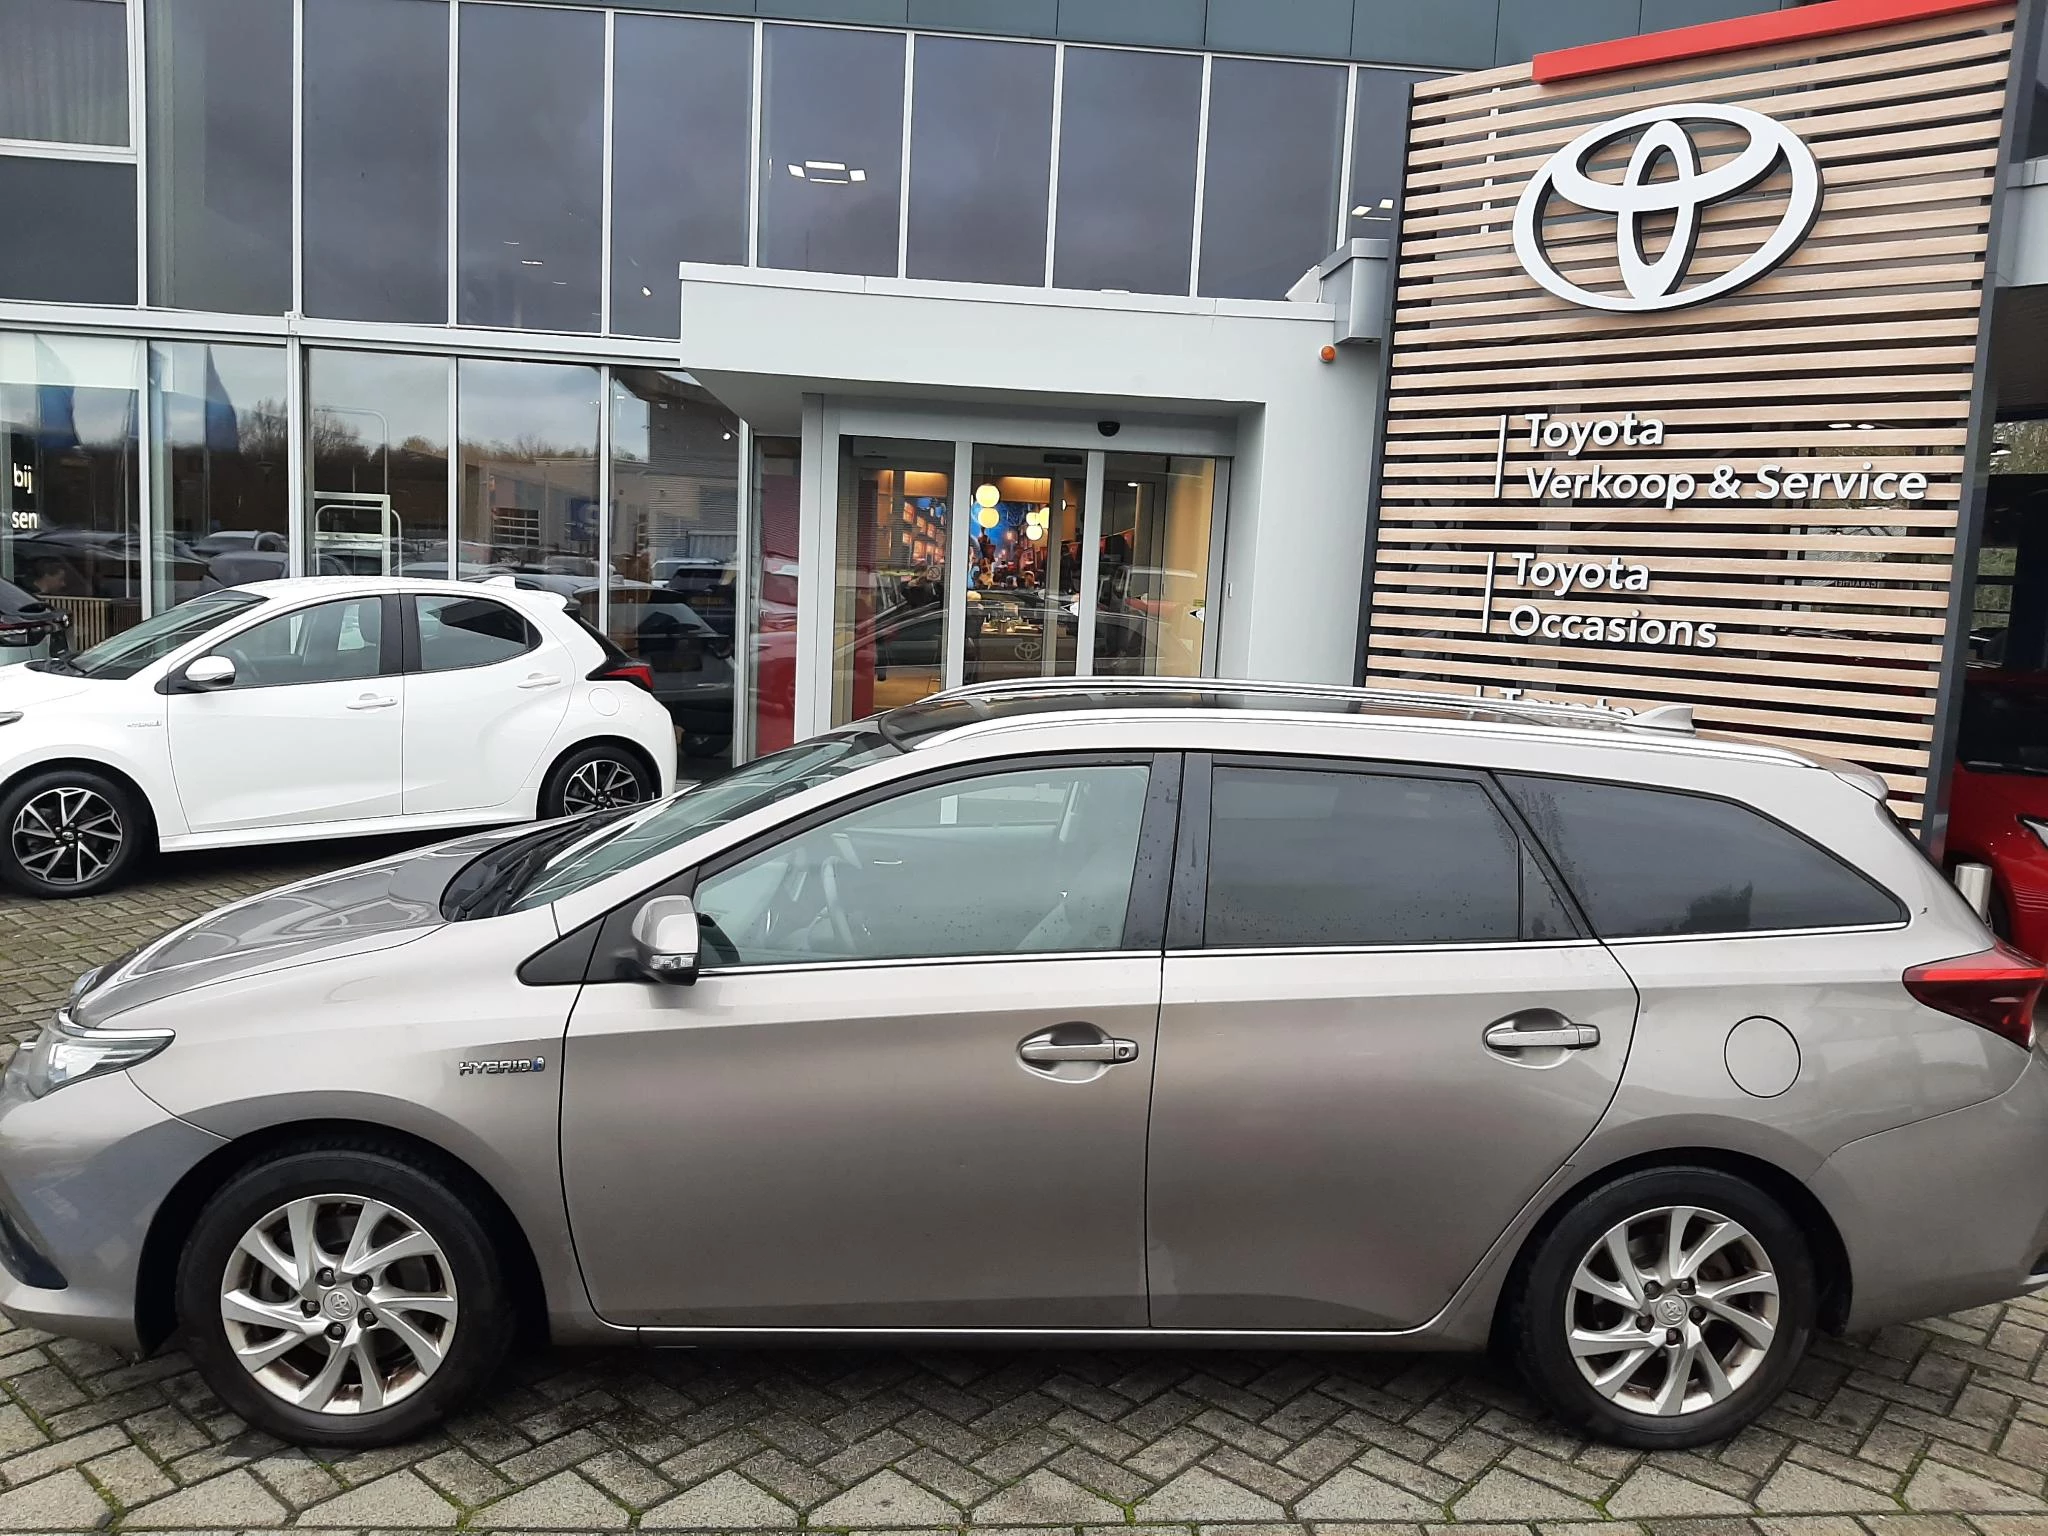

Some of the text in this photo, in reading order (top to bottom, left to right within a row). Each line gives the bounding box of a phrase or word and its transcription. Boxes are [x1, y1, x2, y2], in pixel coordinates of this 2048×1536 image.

[1525, 412, 1664, 456] Toyota
[13, 462, 33, 494] bij
[1526, 461, 1928, 510] Verkoop & Service
[1512, 552, 1650, 596] Toyota
[1509, 604, 1718, 648] Occasions
[458, 1059, 532, 1076] HYBRID
